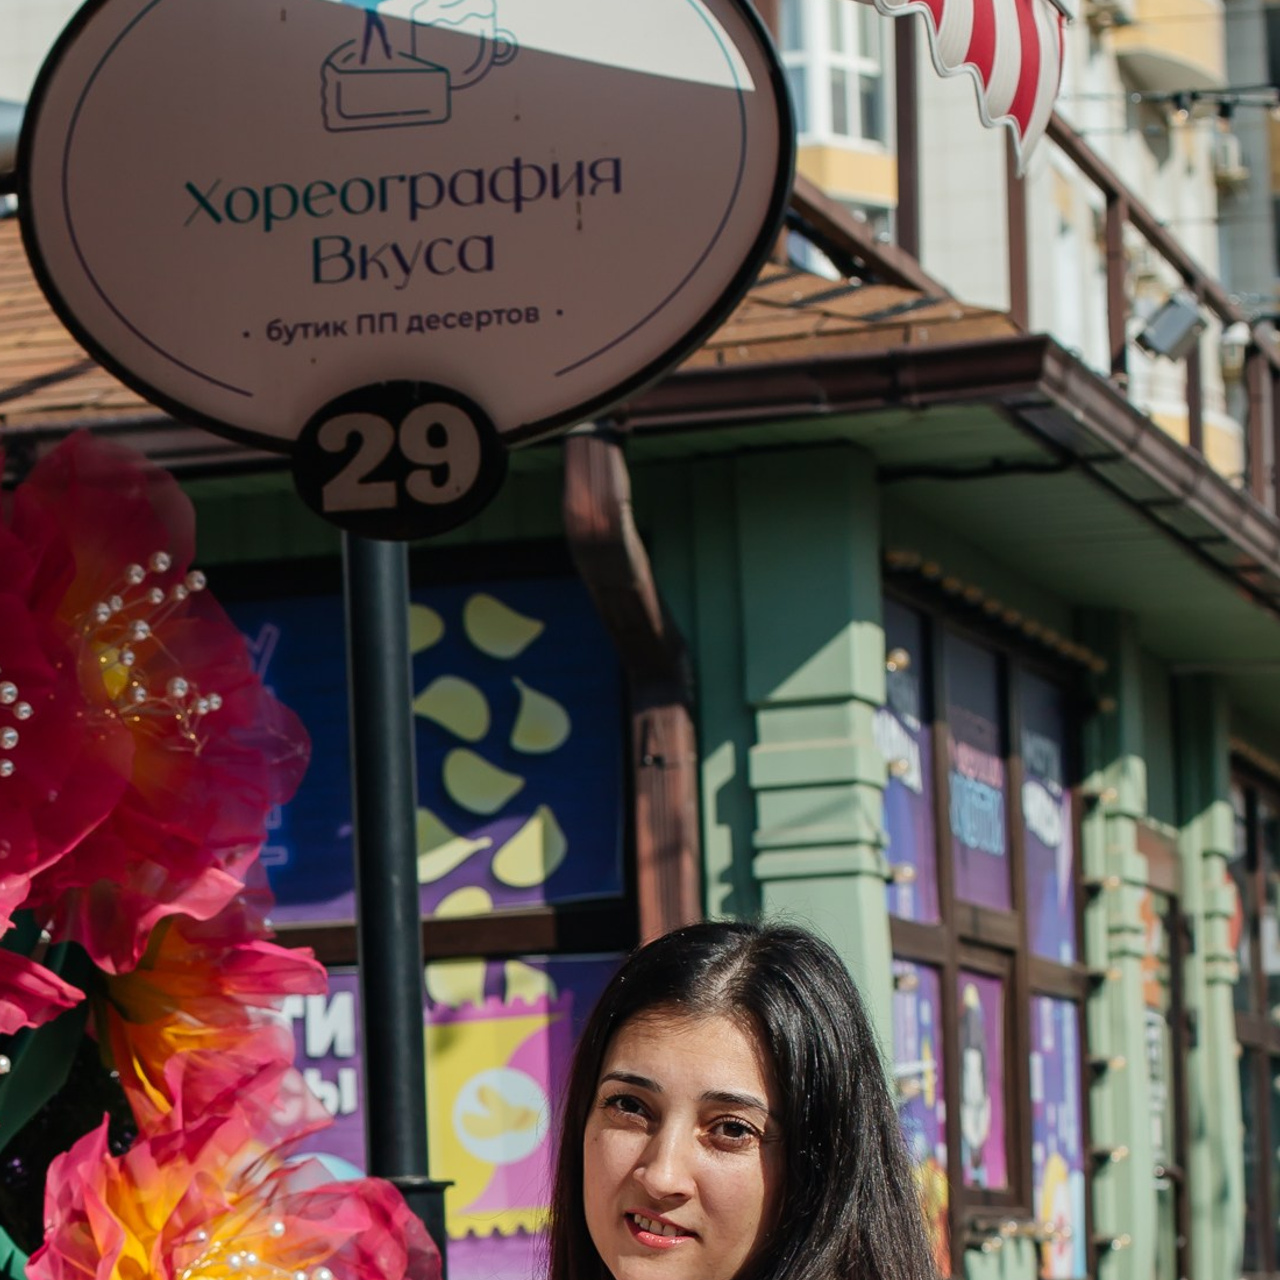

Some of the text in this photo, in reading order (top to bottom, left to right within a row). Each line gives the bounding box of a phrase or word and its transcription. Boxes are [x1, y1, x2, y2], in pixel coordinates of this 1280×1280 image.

[183, 157, 622, 232] Хореография
[312, 234, 495, 290] Вкуса
[266, 305, 540, 345] бутик ПП десертов
[317, 401, 482, 513] 29
